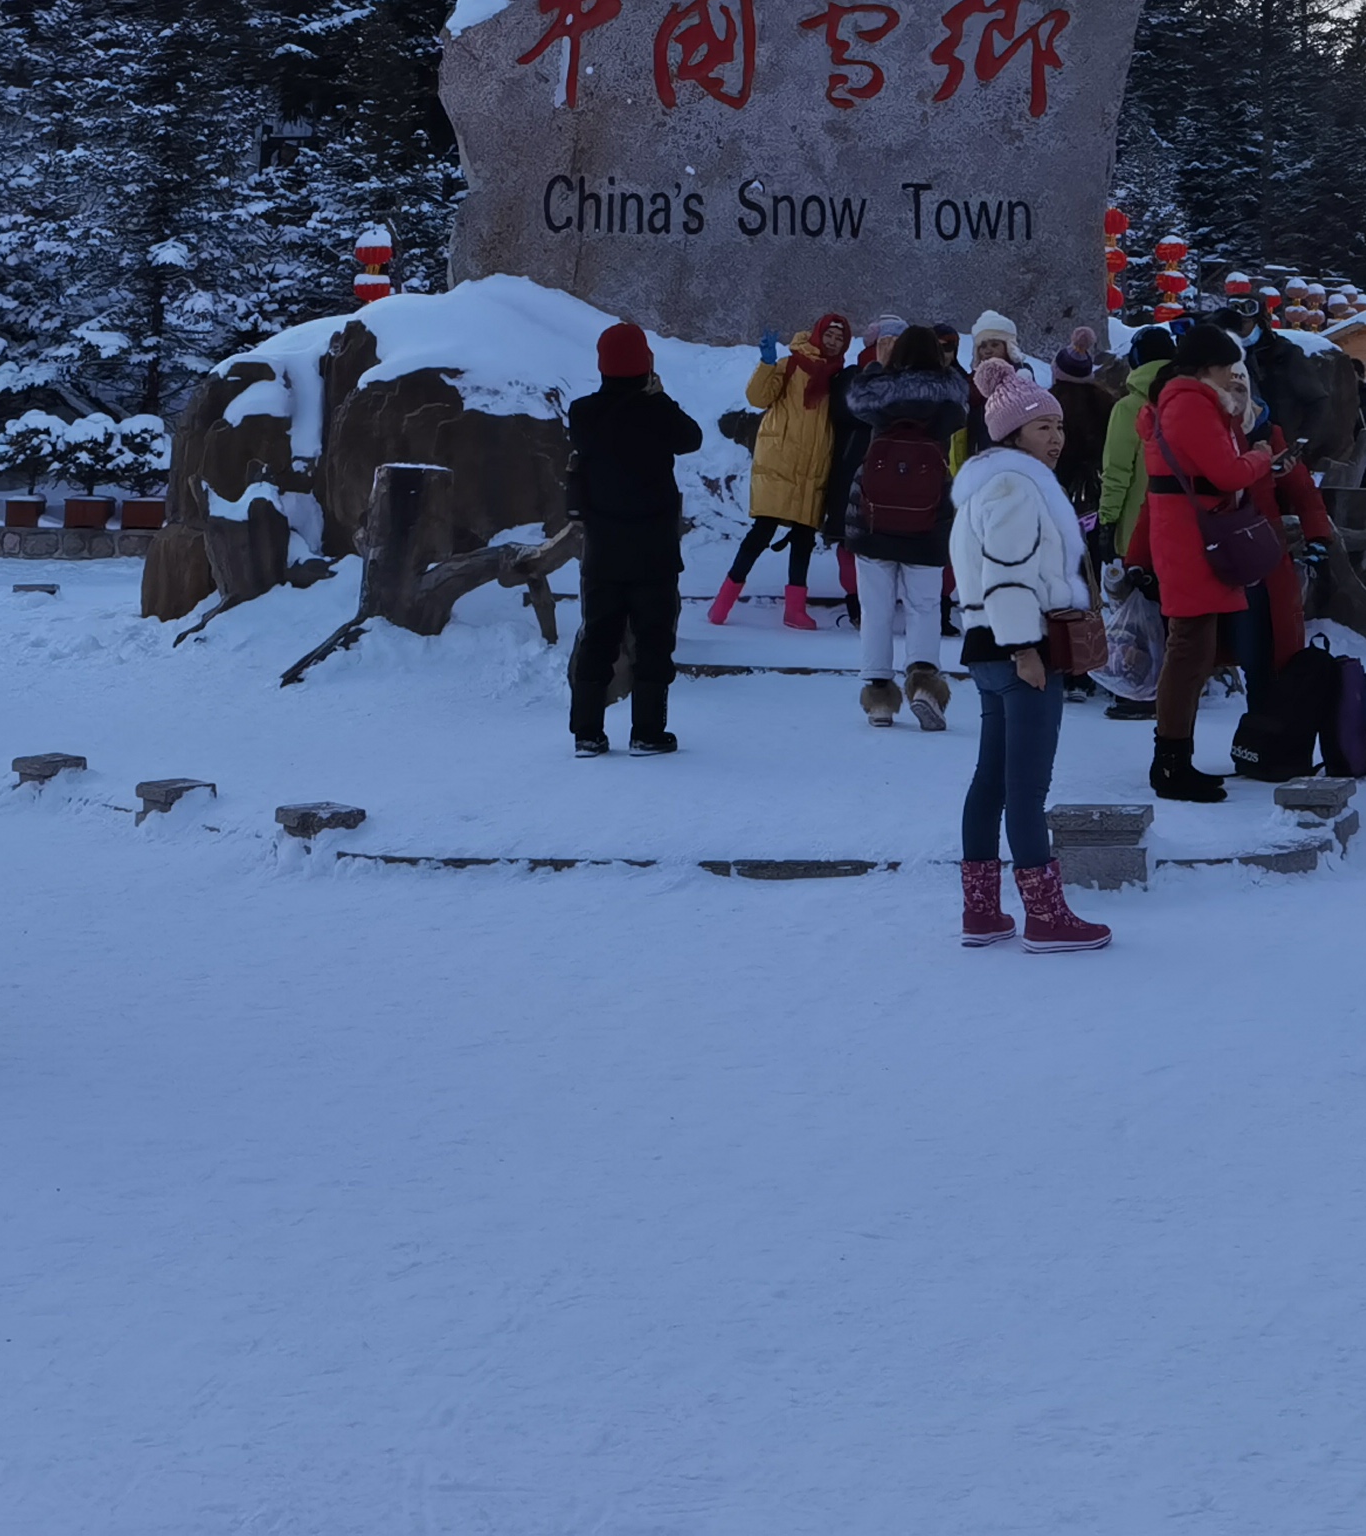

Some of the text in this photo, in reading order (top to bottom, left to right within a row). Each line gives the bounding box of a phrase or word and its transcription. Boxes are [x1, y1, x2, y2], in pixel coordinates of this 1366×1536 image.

[543, 174, 1032, 241] China's Snow Town
